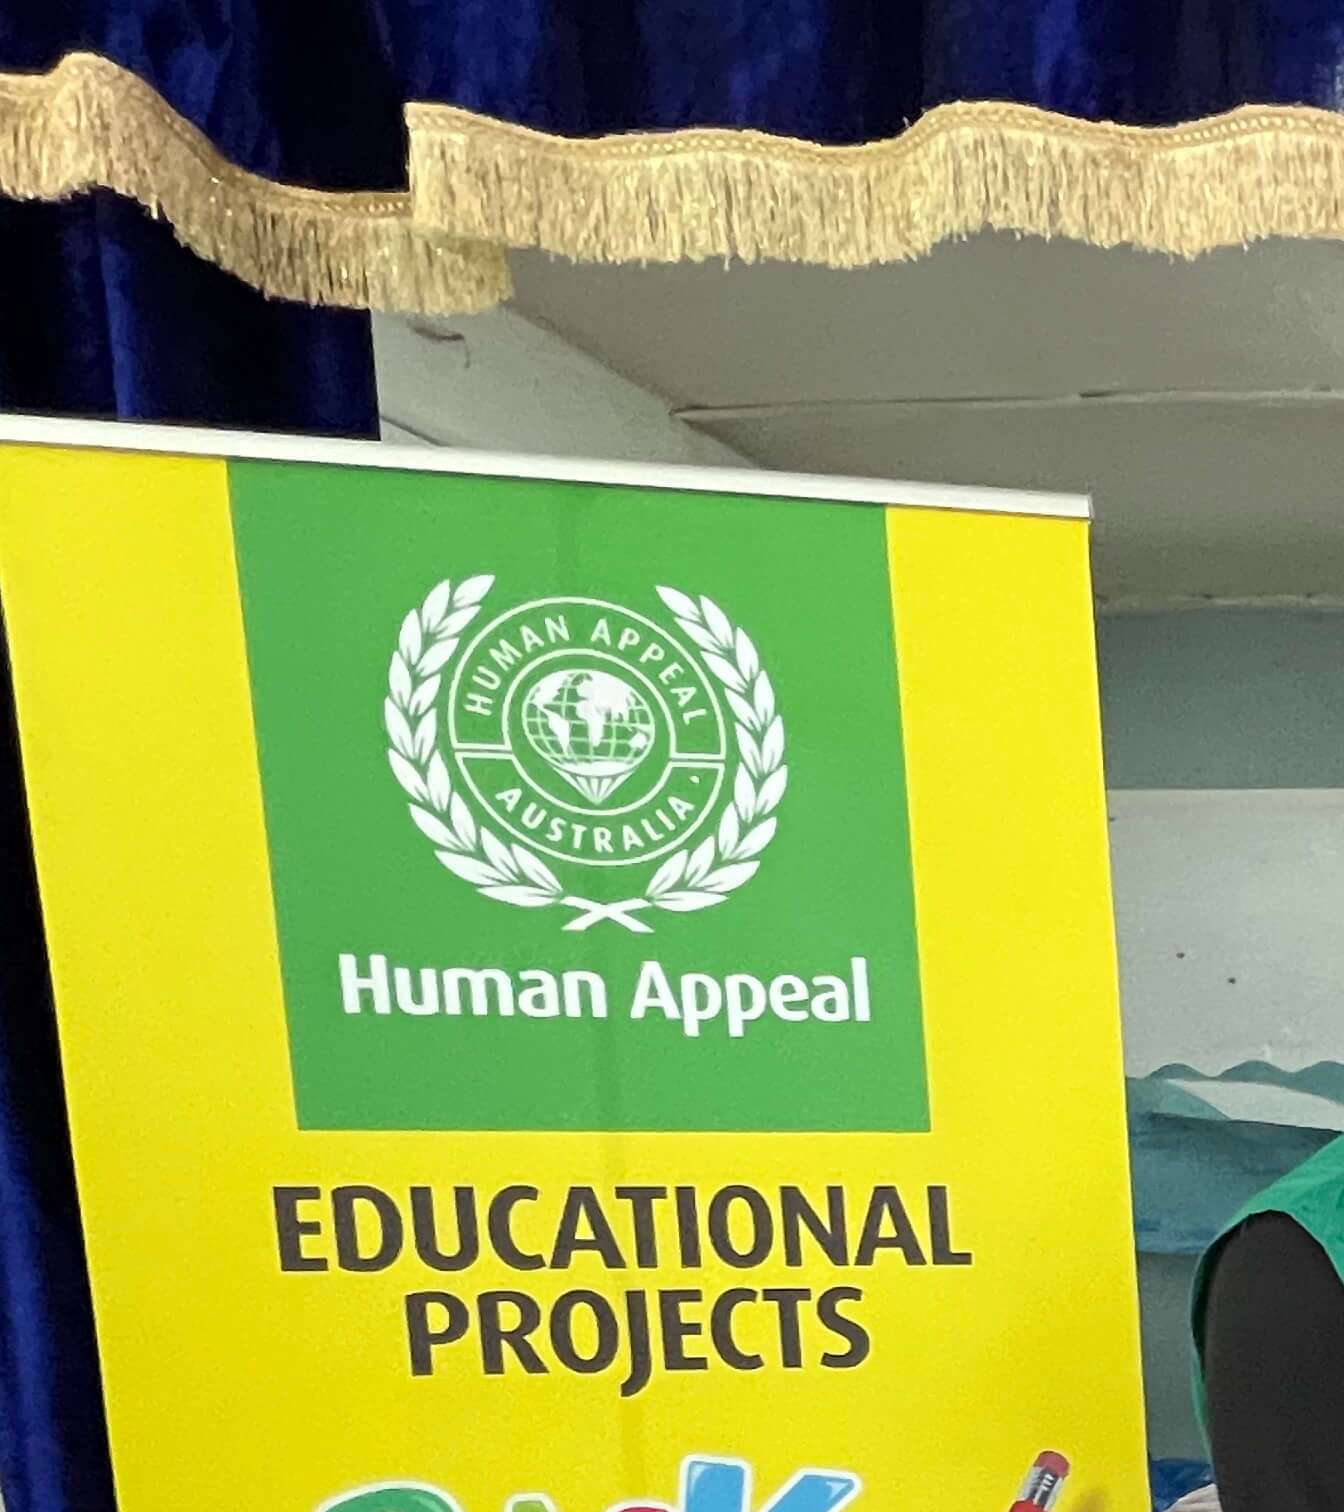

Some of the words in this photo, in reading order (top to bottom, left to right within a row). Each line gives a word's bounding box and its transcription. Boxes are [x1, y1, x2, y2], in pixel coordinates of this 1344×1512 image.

[466, 616, 570, 717] HUMAN
[591, 618, 709, 727] APPEAL
[495, 783, 695, 854] AUSTRALIA
[338, 953, 607, 1019] Human
[630, 957, 872, 1037] Appeal
[272, 1184, 973, 1273] EDUCATIONAL
[404, 1287, 872, 1397] PROJECTS
